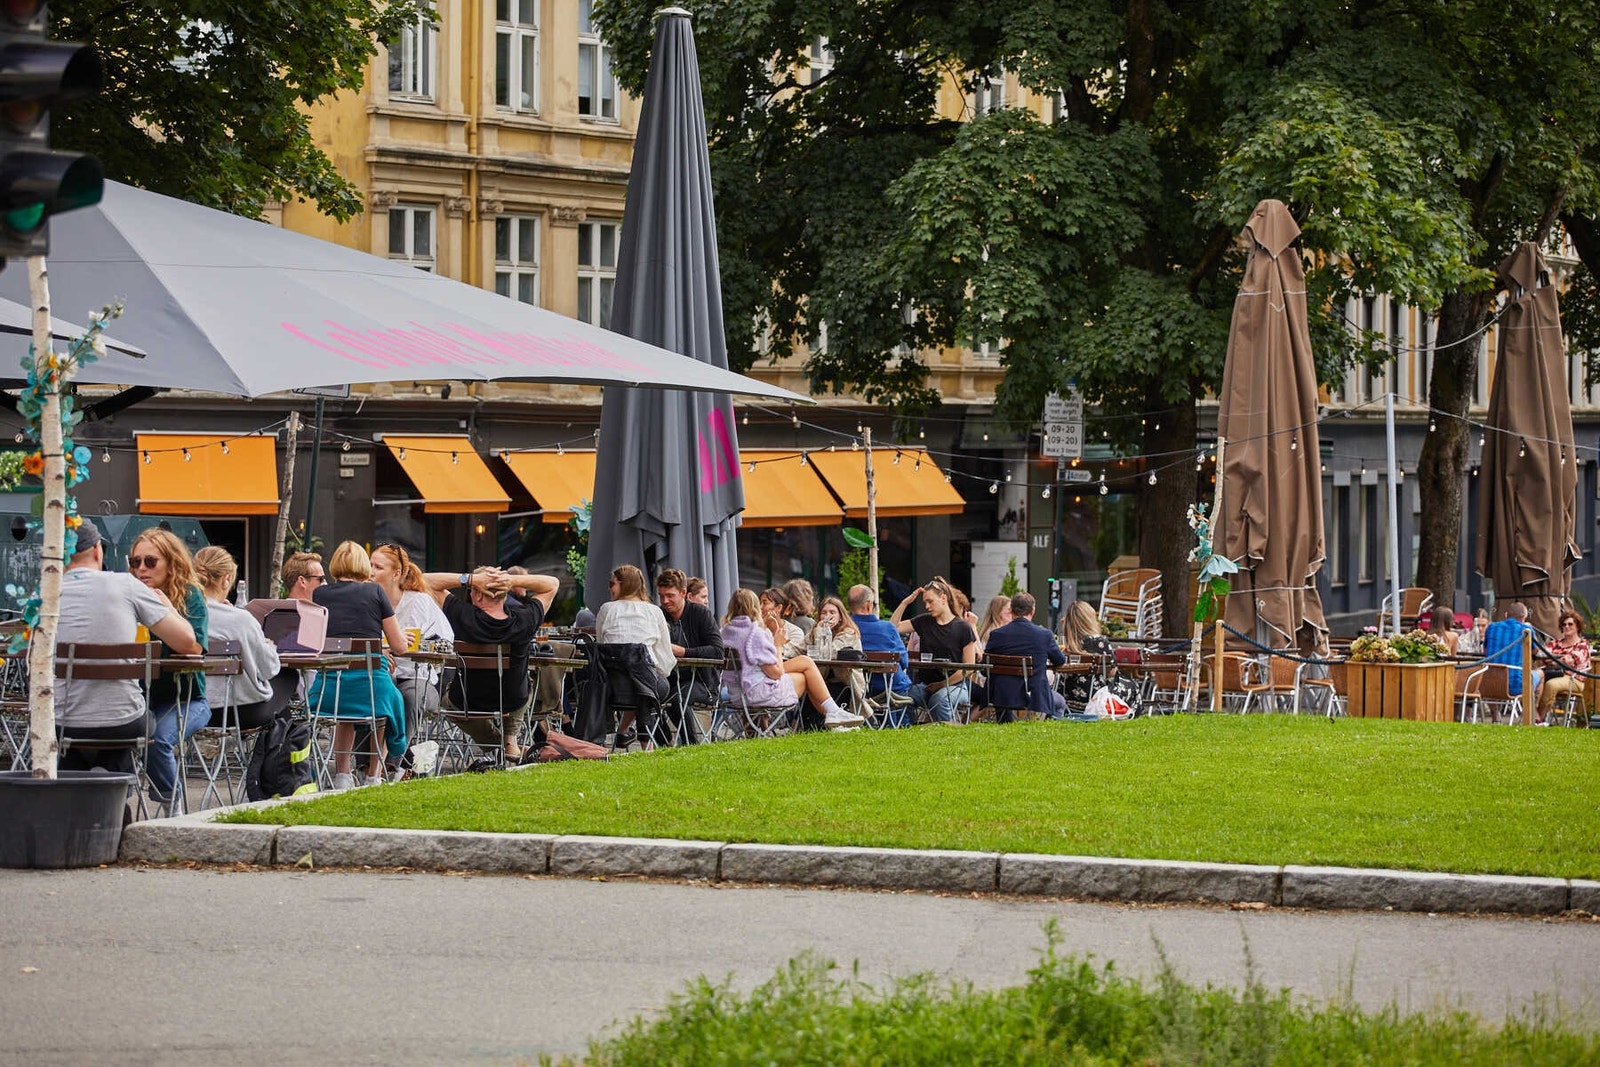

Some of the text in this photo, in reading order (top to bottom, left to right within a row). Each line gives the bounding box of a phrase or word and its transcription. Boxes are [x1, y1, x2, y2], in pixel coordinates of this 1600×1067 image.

[280, 320, 510, 370] Colonel
[1051, 424, 1075, 433] 09-20
[1048, 436, 1077, 446] (09-20)
